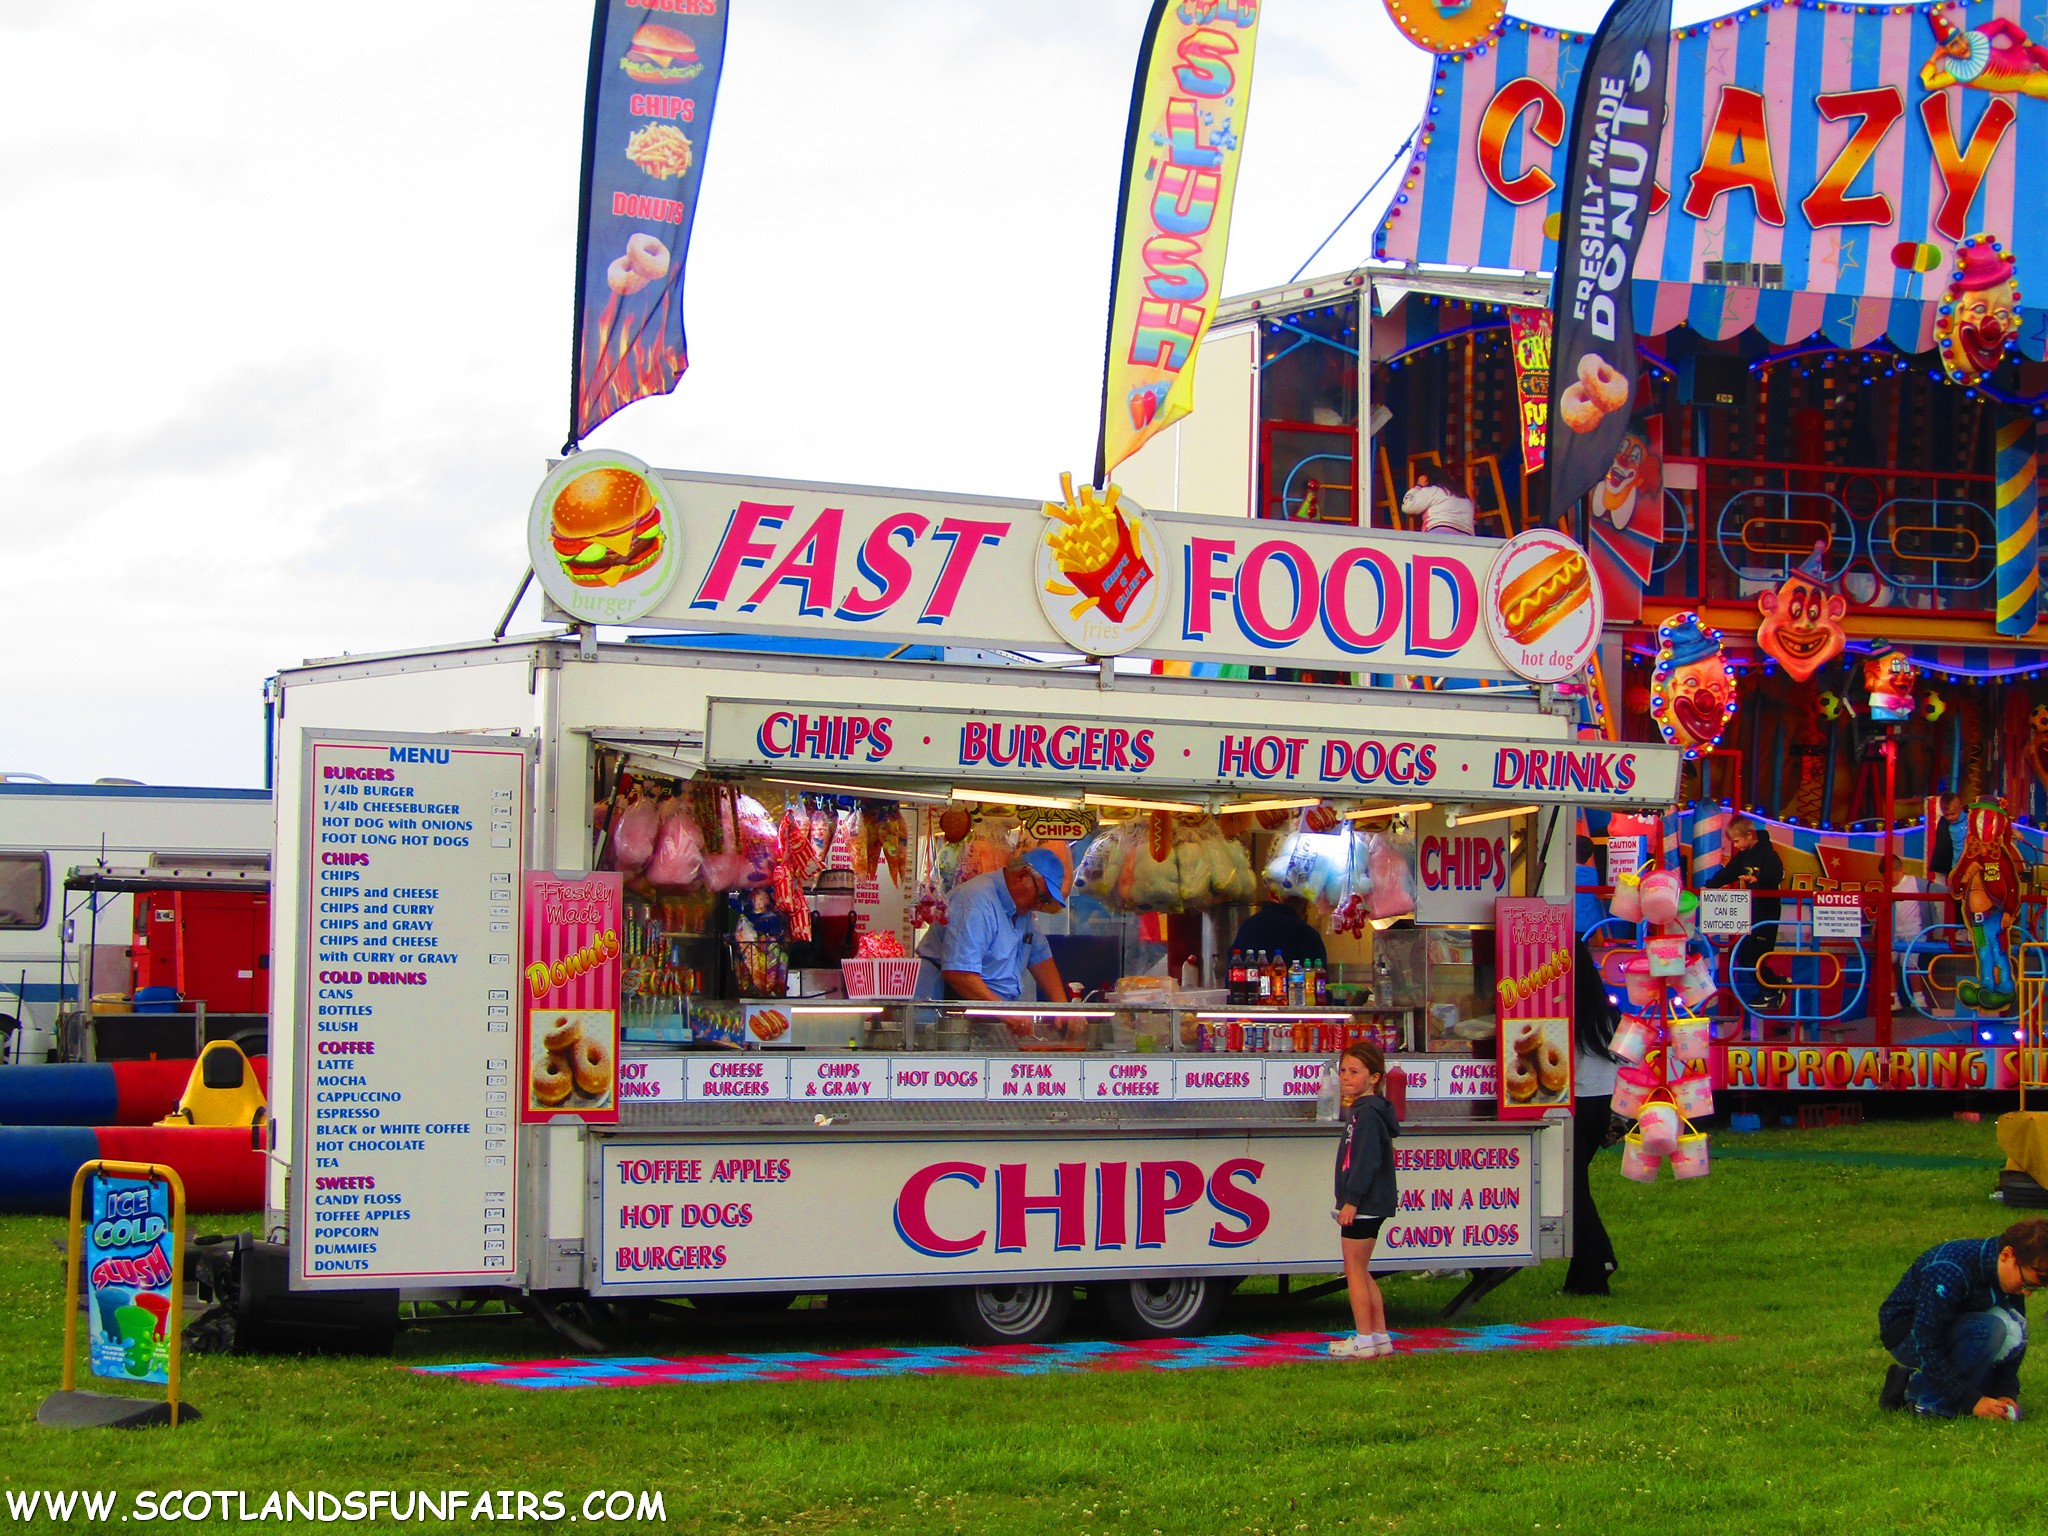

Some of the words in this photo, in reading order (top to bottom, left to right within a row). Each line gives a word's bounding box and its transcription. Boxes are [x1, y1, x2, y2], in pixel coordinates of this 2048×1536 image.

[630, 93, 695, 122] CHIPS
[1588, 76, 1626, 164] MADE
[1477, 76, 2017, 241] CAZY
[1127, 29, 1239, 373] SLUSH
[1591, 49, 1653, 342] DONUTS
[612, 191, 685, 225] DONUTS
[1574, 176, 1605, 321] FRESHLY
[689, 501, 1012, 626] FAST
[1182, 536, 1479, 658] FOOD
[572, 588, 637, 615] burger
[1083, 620, 1120, 642] fries
[1520, 648, 1543, 668] hot
[1547, 649, 1575, 671] dog
[389, 747, 450, 764] MENU
[757, 711, 894, 762] CHIPS
[959, 721, 1156, 774] BURGERS
[1218, 735, 1310, 779] HOT
[1318, 739, 1437, 787] DOGS
[1493, 746, 1637, 796] DRINKS
[324, 766, 395, 781] BURGERS
[324, 785, 358, 795] 1/4lb
[364, 786, 414, 797] BURGER
[324, 801, 358, 811] 1/4lb
[364, 802, 459, 815] CHEESEBURGER
[322, 817, 349, 827] HOT
[355, 818, 383, 829] DOG
[389, 819, 416, 829] with
[422, 820, 473, 831] ONIONS
[1036, 824, 1082, 836] CHIPS
[322, 833, 356, 844] FOOT
[362, 834, 396, 845] LONG
[402, 836, 428, 846] HOT
[434, 837, 469, 847] DOGS
[1609, 841, 1636, 849] CAUTION
[322, 852, 369, 866] CHIPS
[1420, 835, 1506, 892] CHIPS
[321, 871, 359, 881] CHIPS
[321, 887, 359, 897] CHIPS
[364, 887, 388, 898] and
[393, 888, 439, 899] CHEESE
[534, 880, 614, 909] Freshly
[1703, 893, 1728, 903] MOVING
[1730, 894, 1748, 904] STEPS
[1817, 894, 1859, 904] NOTICE
[321, 903, 359, 914] CHIPS
[364, 904, 387, 914] and
[393, 904, 434, 915] CURRY
[547, 904, 601, 925] Made
[1714, 907, 1727, 916] CAN
[1729, 908, 1738, 916] BE
[320, 920, 358, 930] CHIPS
[364, 920, 387, 930] and
[393, 921, 433, 931] GRAVY
[1502, 906, 1566, 931] Freshly
[1703, 920, 1734, 930] SWITCHED
[1736, 921, 1749, 930] OFF
[320, 936, 358, 946] CHIPS
[364, 936, 387, 946] and
[392, 937, 438, 947] CHEESE
[1513, 926, 1556, 945] Made
[320, 952, 348, 962] with
[354, 953, 395, 962] CURRY
[401, 955, 413, 963] or
[418, 953, 458, 963] GRAVY
[525, 928, 620, 1000] Donuts
[319, 971, 362, 984] COLD
[368, 972, 427, 985] DRINKS
[1498, 947, 1572, 1010] Donuts
[319, 989, 353, 999] CANS
[319, 1006, 372, 1016] BOTTLES
[318, 1022, 358, 1032] SLUSH
[318, 1041, 375, 1054] COFFEE
[317, 1060, 354, 1070] LATTE
[710, 1063, 764, 1078] CHEESE
[817, 1063, 860, 1078] CHIPS
[1011, 1064, 1053, 1079] STEAK
[1109, 1064, 1148, 1079] CHIPS
[1293, 1065, 1321, 1079] HOT
[1451, 1064, 1496, 1079] CHICKE
[1727, 1049, 1988, 1087] RIPROARING
[317, 1076, 366, 1086] MOCHA
[897, 1070, 929, 1086] HOT
[934, 1071, 978, 1086] DOGS
[1186, 1072, 1251, 1088] BURGERS
[619, 1081, 661, 1098] RINKS
[703, 1081, 769, 1096] BURGERS
[806, 1082, 817, 1096] &
[823, 1082, 872, 1096] GRAVY
[1003, 1082, 1020, 1097] IN
[1023, 1082, 1034, 1096] A
[1037, 1082, 1066, 1097] BUN
[1097, 1082, 1109, 1096] &
[1113, 1081, 1160, 1097] CHEESE
[1283, 1081, 1322, 1095] DRINK
[1450, 1081, 1464, 1095] IN
[1467, 1082, 1476, 1095] A
[1479, 1081, 1496, 1095] BU
[317, 1092, 401, 1102] CAPPUCCINO
[317, 1109, 380, 1118] ESPRESSO
[317, 1124, 357, 1135] BLACK
[363, 1126, 376, 1134] or
[381, 1124, 421, 1135] WHITE
[425, 1124, 470, 1134] COFFEE
[316, 1141, 343, 1151] HOT
[349, 1140, 425, 1151] CHOCOLATE
[316, 1158, 339, 1168] TEA
[1393, 1148, 1520, 1170] EESEBURGERS
[617, 1159, 702, 1185] TOFFEE
[710, 1158, 792, 1183] APPLES
[316, 1176, 375, 1190] SWEETS
[107, 1187, 150, 1219] ICE
[316, 1195, 358, 1205] CANDY
[364, 1194, 401, 1204] FLOSS
[1431, 1188, 1453, 1210] IN
[1458, 1188, 1474, 1210] A
[1479, 1187, 1520, 1210] BUN
[316, 1211, 360, 1221] TOFFEE
[365, 1210, 410, 1220] APPLES
[893, 1158, 1270, 1258] CHIPS
[620, 1204, 674, 1229] HOT
[681, 1203, 753, 1228] DOGS
[94, 1216, 167, 1247] COLD
[315, 1227, 378, 1237] POPCORN
[1386, 1226, 1456, 1249] CANDY
[1463, 1224, 1520, 1247] FLOSS
[315, 1243, 377, 1254] DUMMIES
[315, 1260, 368, 1270] DONUTS
[616, 1245, 727, 1271] BURGERS
[92, 1244, 173, 1291] SLUSH
